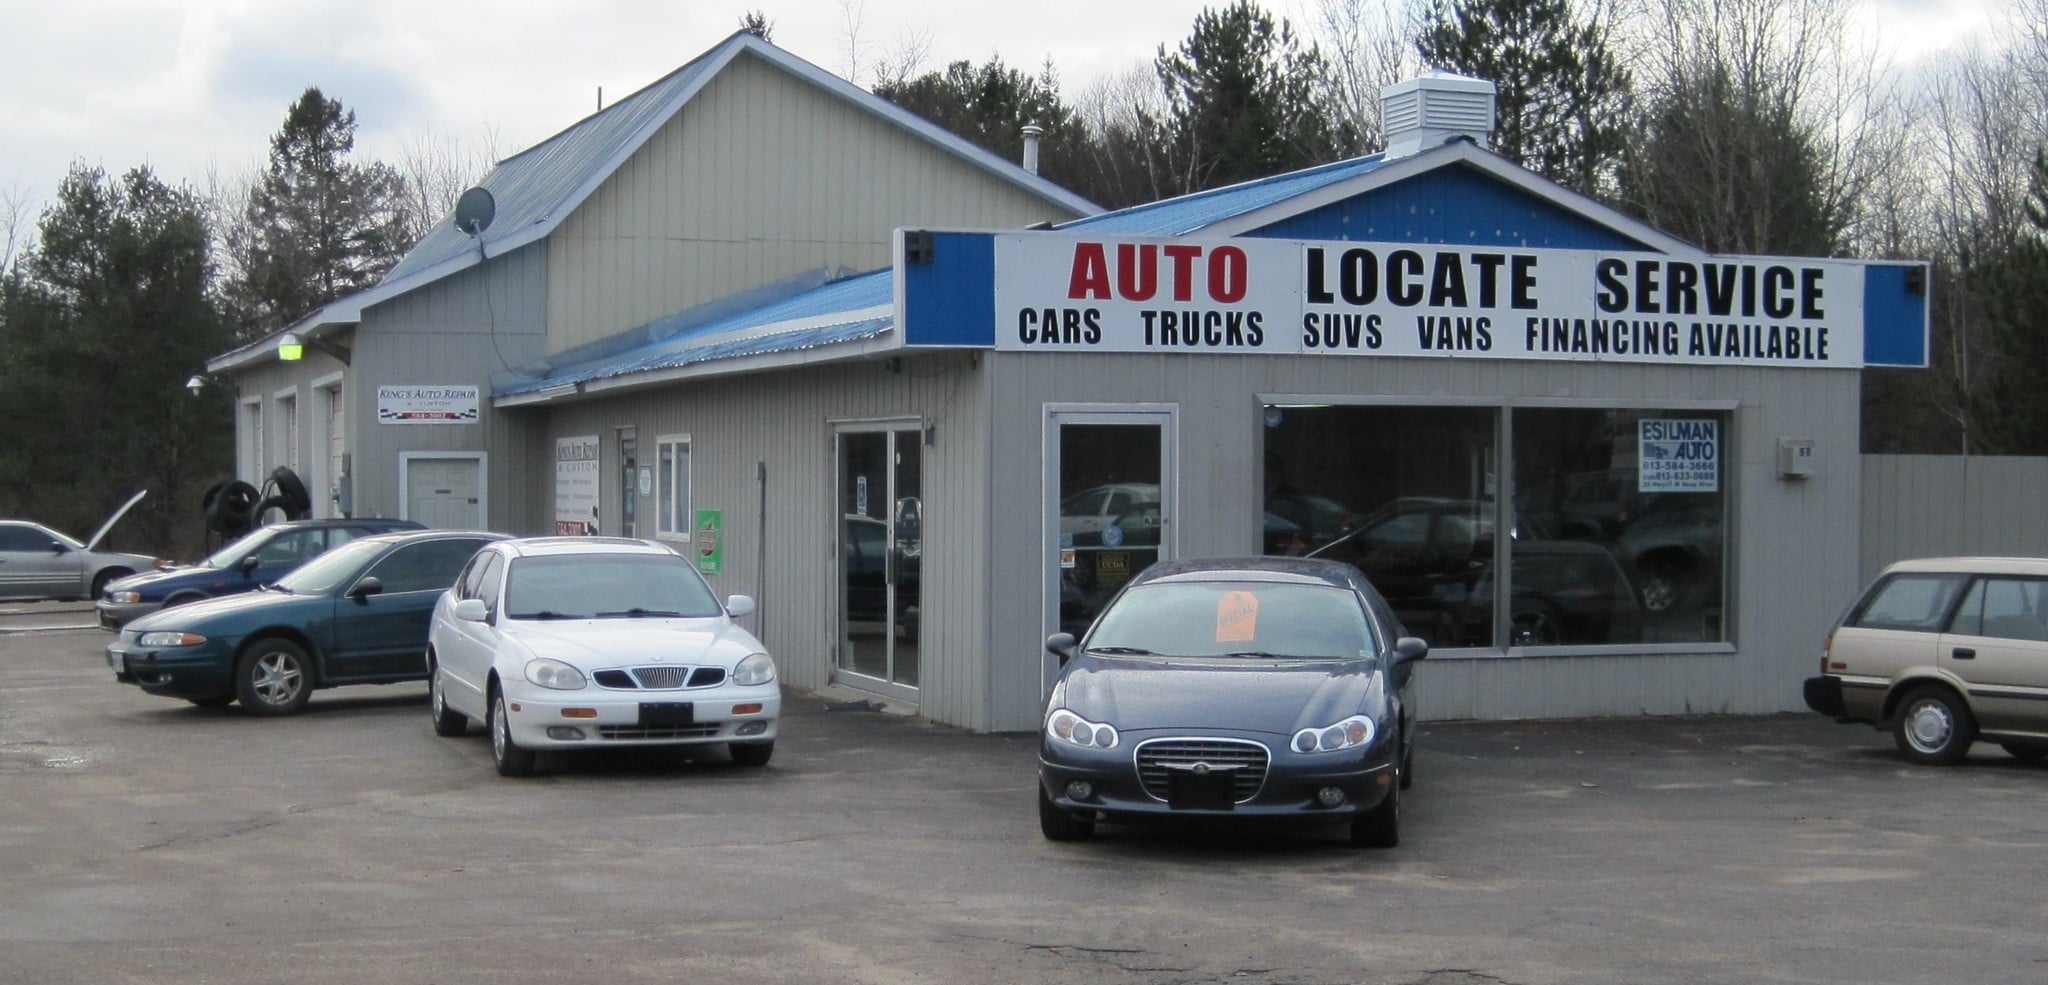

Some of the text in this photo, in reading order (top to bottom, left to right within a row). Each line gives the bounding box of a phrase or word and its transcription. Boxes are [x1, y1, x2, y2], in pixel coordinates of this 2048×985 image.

[1067, 242, 1825, 320] AUTO LOCATE SERVICE
[1018, 307, 1829, 361] CARS TRUCKS SUVS VANS FINANCING AVAILABLE
[379, 388, 476, 399] KING'S AUTO REPAIR
[1642, 422, 1714, 440] ESILMAN
[1674, 441, 1714, 460] AUTO
